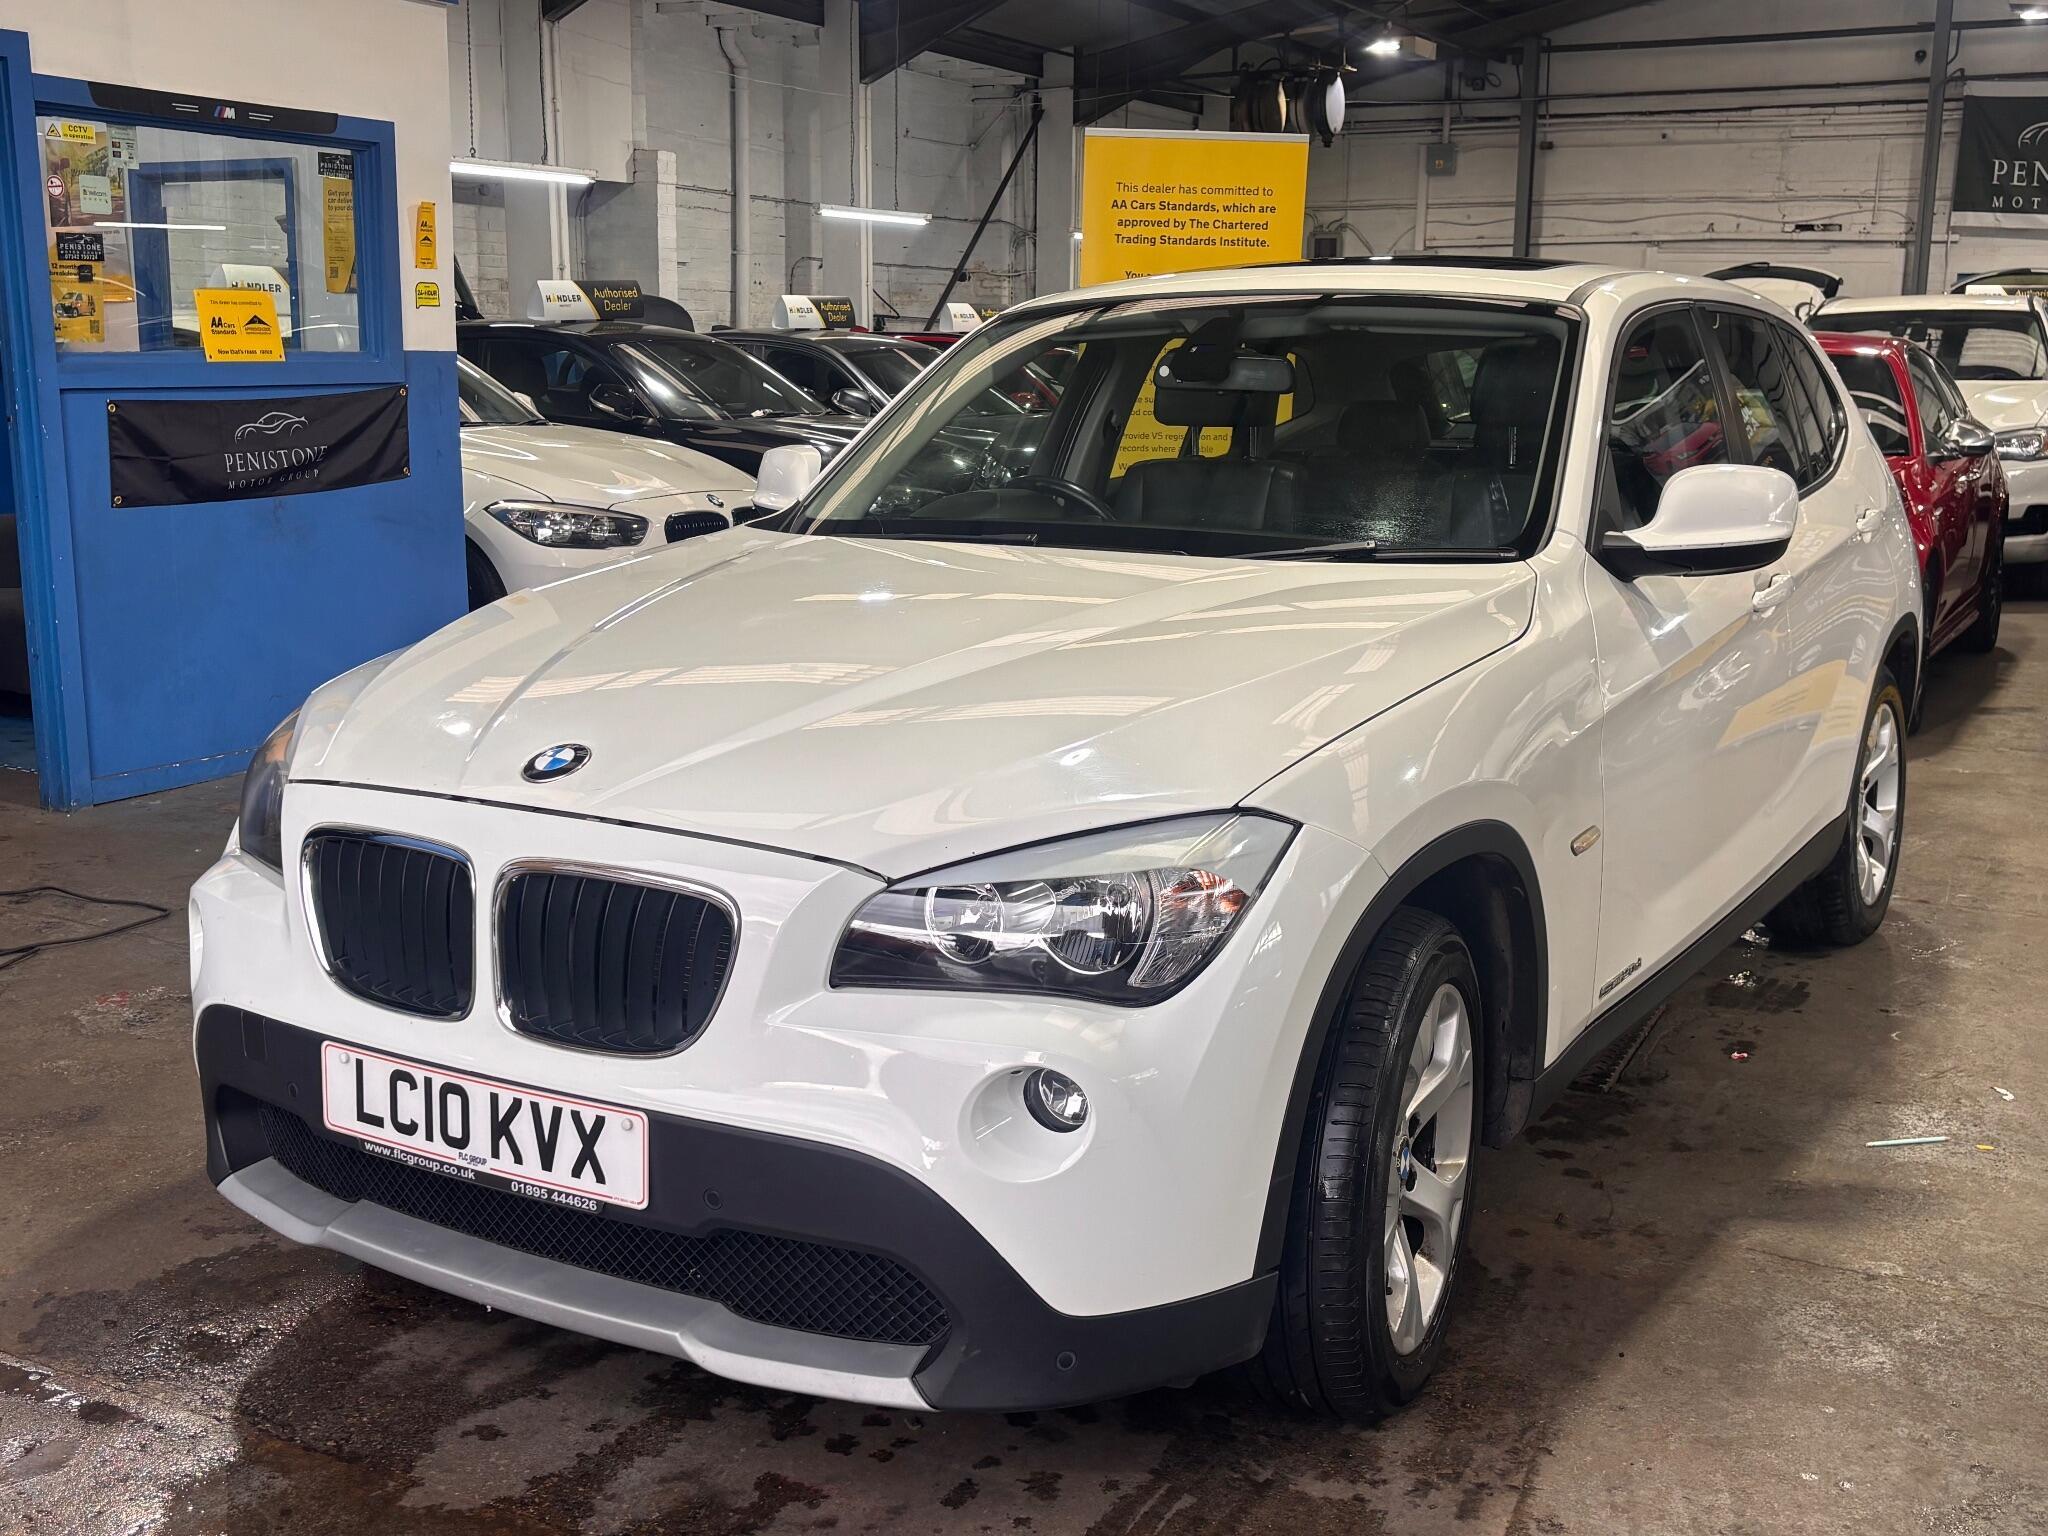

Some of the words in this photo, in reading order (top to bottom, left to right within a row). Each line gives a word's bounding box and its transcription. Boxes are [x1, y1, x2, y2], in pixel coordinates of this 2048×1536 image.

[68, 125, 88, 133] CCTV
[1116, 182, 1139, 193] This
[1141, 183, 1175, 194] dealer
[1178, 184, 1198, 195] has
[1200, 185, 1259, 196] committed
[1262, 187, 1274, 196] to
[1111, 200, 1128, 210] AA
[1130, 200, 1156, 210] Cars
[1159, 201, 1220, 214] Standards,
[1222, 202, 1256, 213] which
[1258, 204, 1277, 214] are
[1117, 218, 1170, 230] approved
[1173, 218, 1186, 230] by
[1189, 218, 1210, 229] The
[1212, 219, 1269, 231] Chartered
[60, 243, 101, 251] PENISTONE
[1114, 234, 1157, 246] Trading
[1159, 235, 1217, 246] Standards
[1219, 236, 1270, 248] Institute.
[1125, 271, 1144, 279] You
[594, 287, 638, 298] Authorised
[604, 300, 631, 311] Dealer
[820, 301, 851, 311] Authorised
[211, 316, 223, 328] AA
[828, 312, 847, 321] Dealer
[1213, 432, 1228, 441] and
[1151, 445, 1176, 453] where
[224, 446, 328, 473] PENISTONE
[355, 1057, 470, 1151] LC10
[489, 1091, 607, 1185] KVX
[364, 1141, 476, 1181] www.flcgroup.co.uk
[469, 1154, 488, 1166] GROUP
[511, 1181, 548, 1199] 01895
[551, 1191, 598, 1211] 444626
